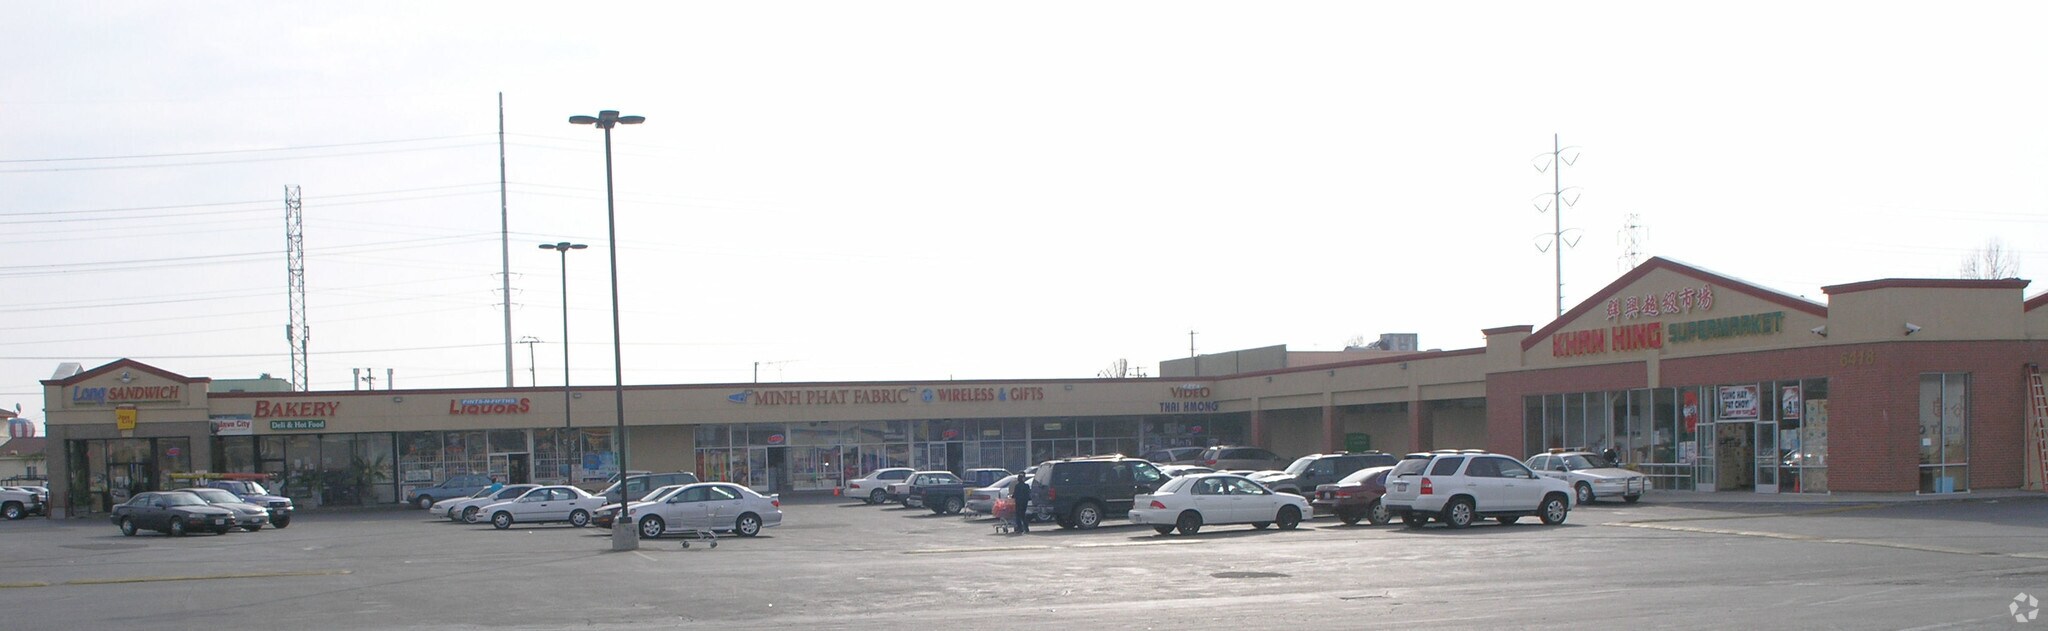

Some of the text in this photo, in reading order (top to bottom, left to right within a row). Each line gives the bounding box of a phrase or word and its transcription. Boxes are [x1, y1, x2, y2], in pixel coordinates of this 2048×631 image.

[1552, 311, 1786, 357] KHAN HING SUPERMARKET
[1840, 350, 1875, 367] 6418
[73, 386, 179, 406] Long SANDWICH
[754, 388, 910, 406] MINH PHAT FABRIC
[938, 387, 1044, 401] WIRELESS & GIFTS
[1171, 387, 1210, 398] VIDEO
[253, 400, 340, 418] BAKERY
[1160, 401, 1218, 413] THAI HMONG
[271, 420, 325, 429] Deli & Hot Food
